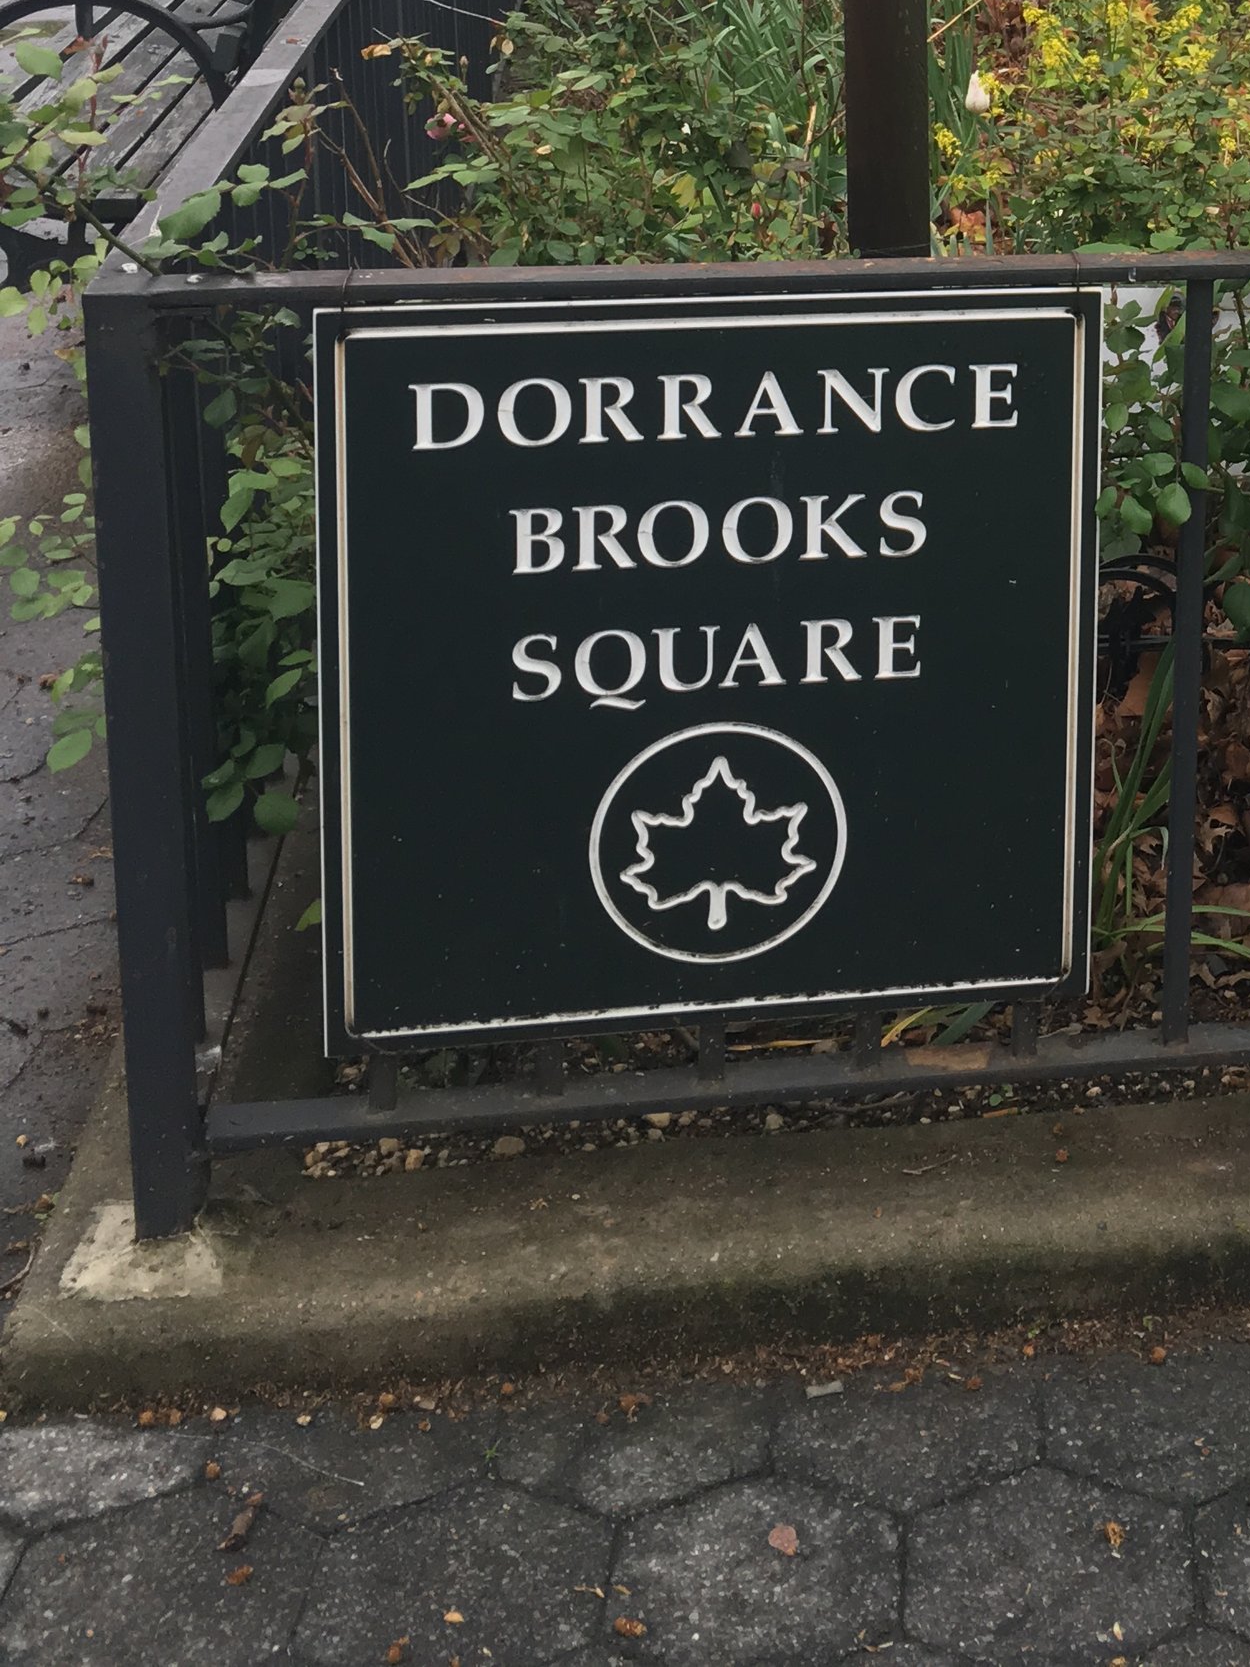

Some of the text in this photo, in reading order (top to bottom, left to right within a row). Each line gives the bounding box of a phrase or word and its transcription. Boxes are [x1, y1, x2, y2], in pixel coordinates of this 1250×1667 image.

[408, 362, 1019, 451] DORRANCE
[508, 489, 928, 575] BROOKS
[510, 614, 922, 709] SQUARE
